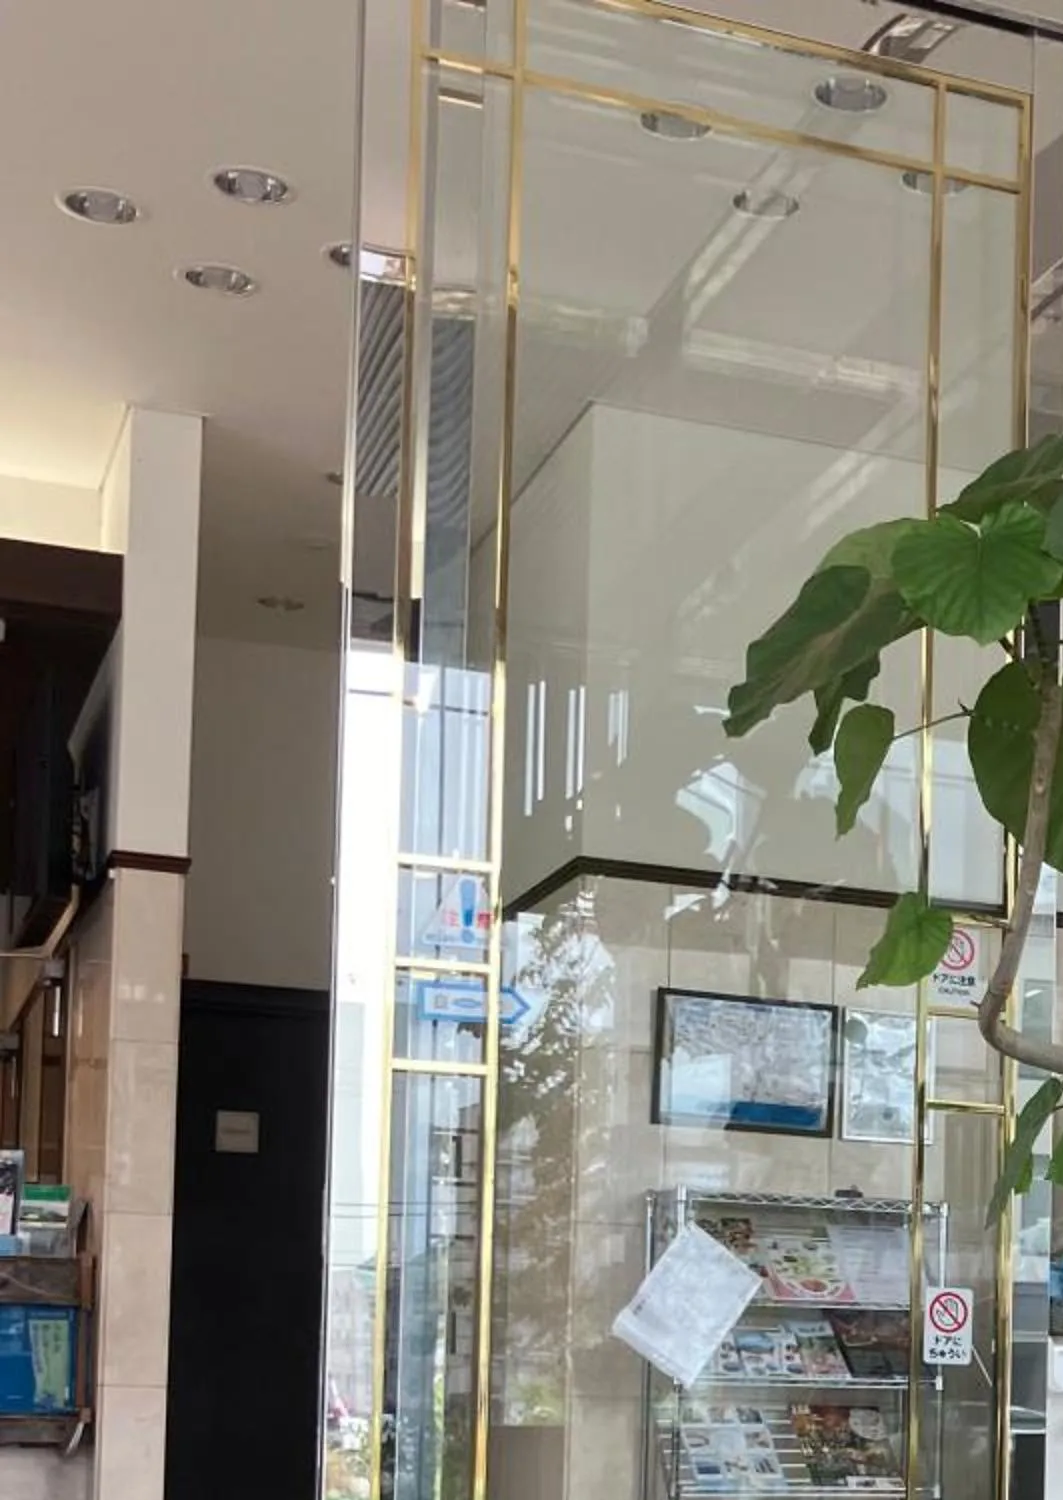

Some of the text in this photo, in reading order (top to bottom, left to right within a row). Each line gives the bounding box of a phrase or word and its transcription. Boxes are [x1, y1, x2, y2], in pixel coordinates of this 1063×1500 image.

[934, 1335, 963, 1346] ドアに
[929, 1347, 967, 1359] ちゅうい
